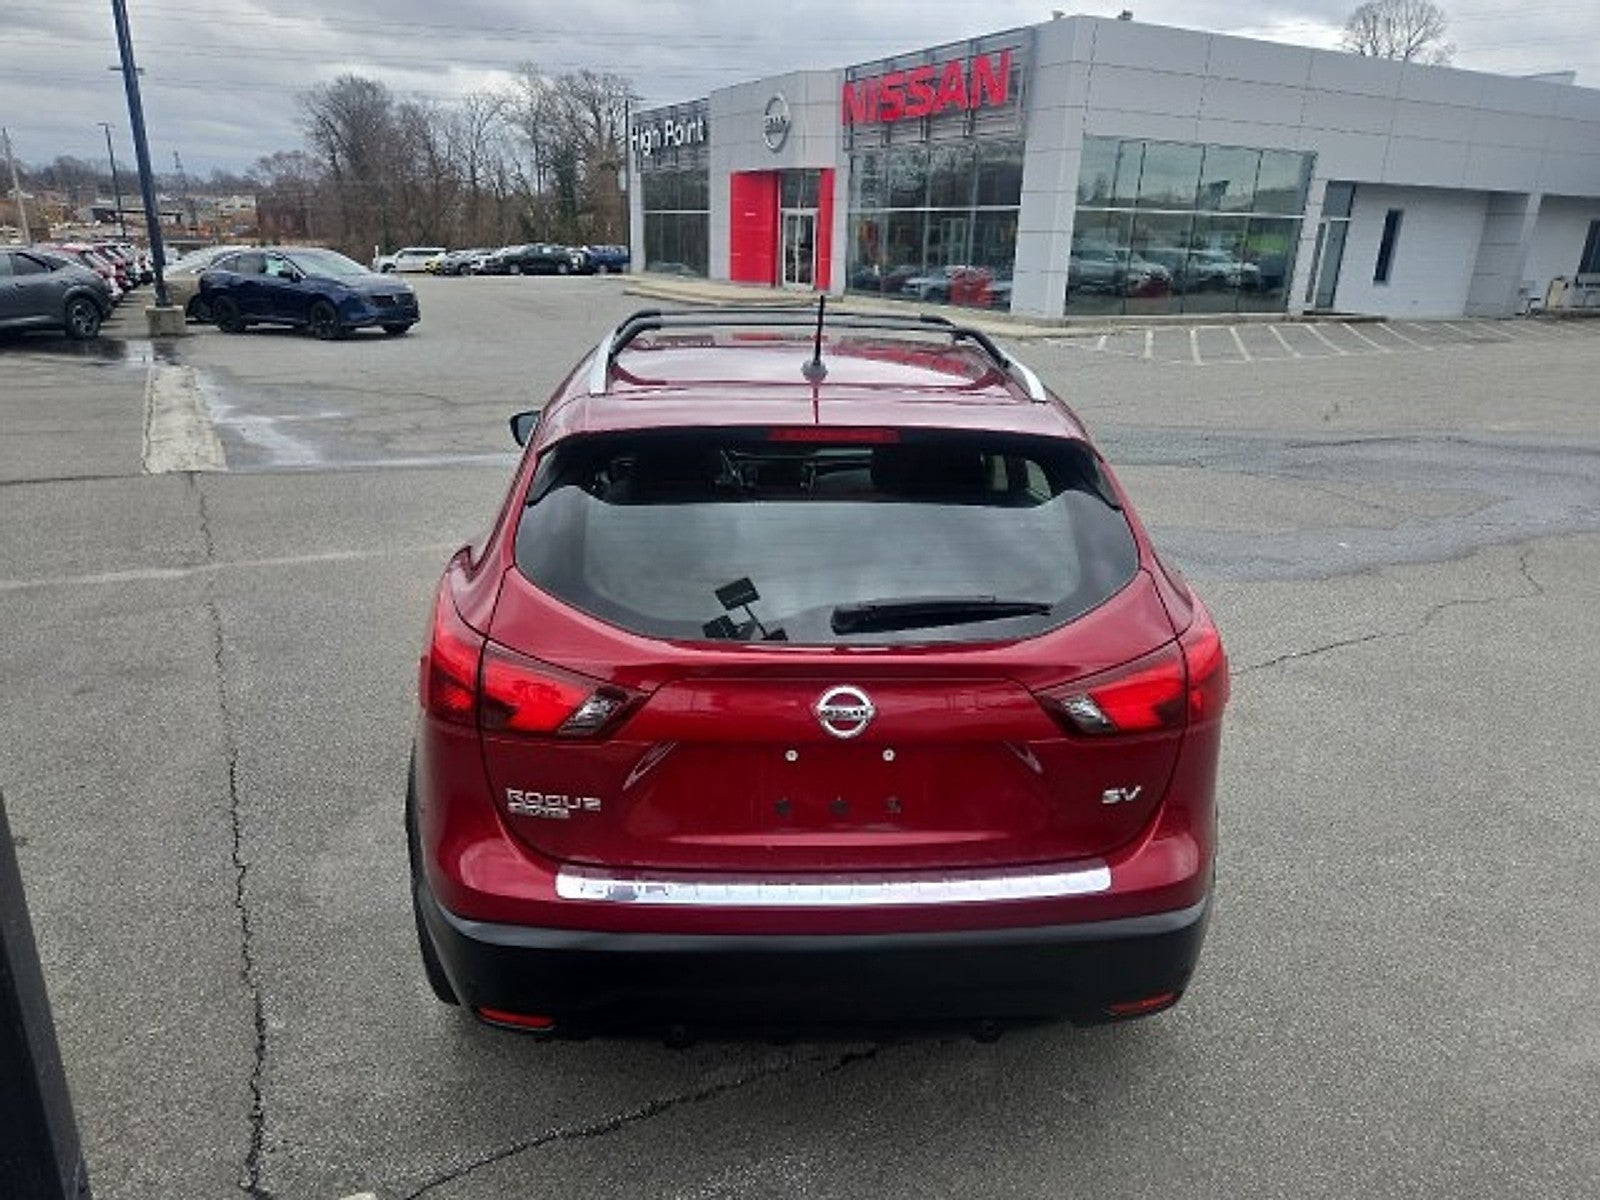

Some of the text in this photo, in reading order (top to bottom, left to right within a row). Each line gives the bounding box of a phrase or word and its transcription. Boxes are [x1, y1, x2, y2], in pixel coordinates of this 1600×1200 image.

[842, 49, 1012, 126] NISSAN
[630, 122, 661, 157] High
[1101, 784, 1142, 804] SV
